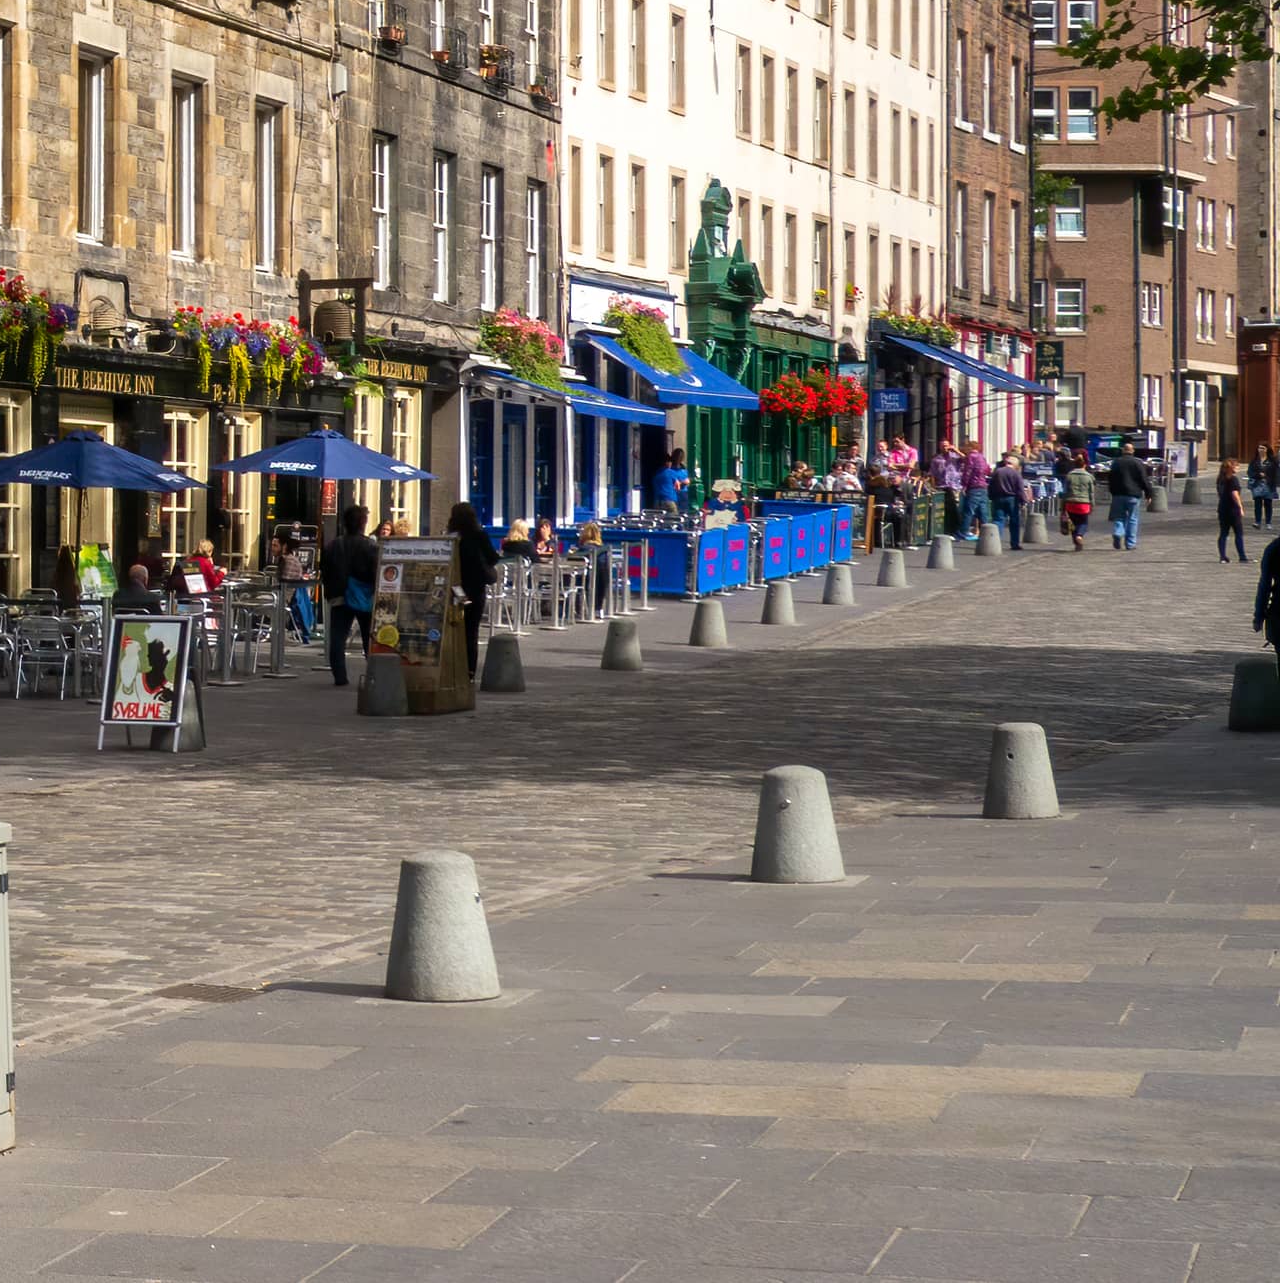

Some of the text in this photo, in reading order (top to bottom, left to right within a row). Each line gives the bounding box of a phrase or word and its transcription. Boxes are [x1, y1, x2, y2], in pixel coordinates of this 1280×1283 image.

[55, 366, 155, 394] THE BEEHIVE INN
